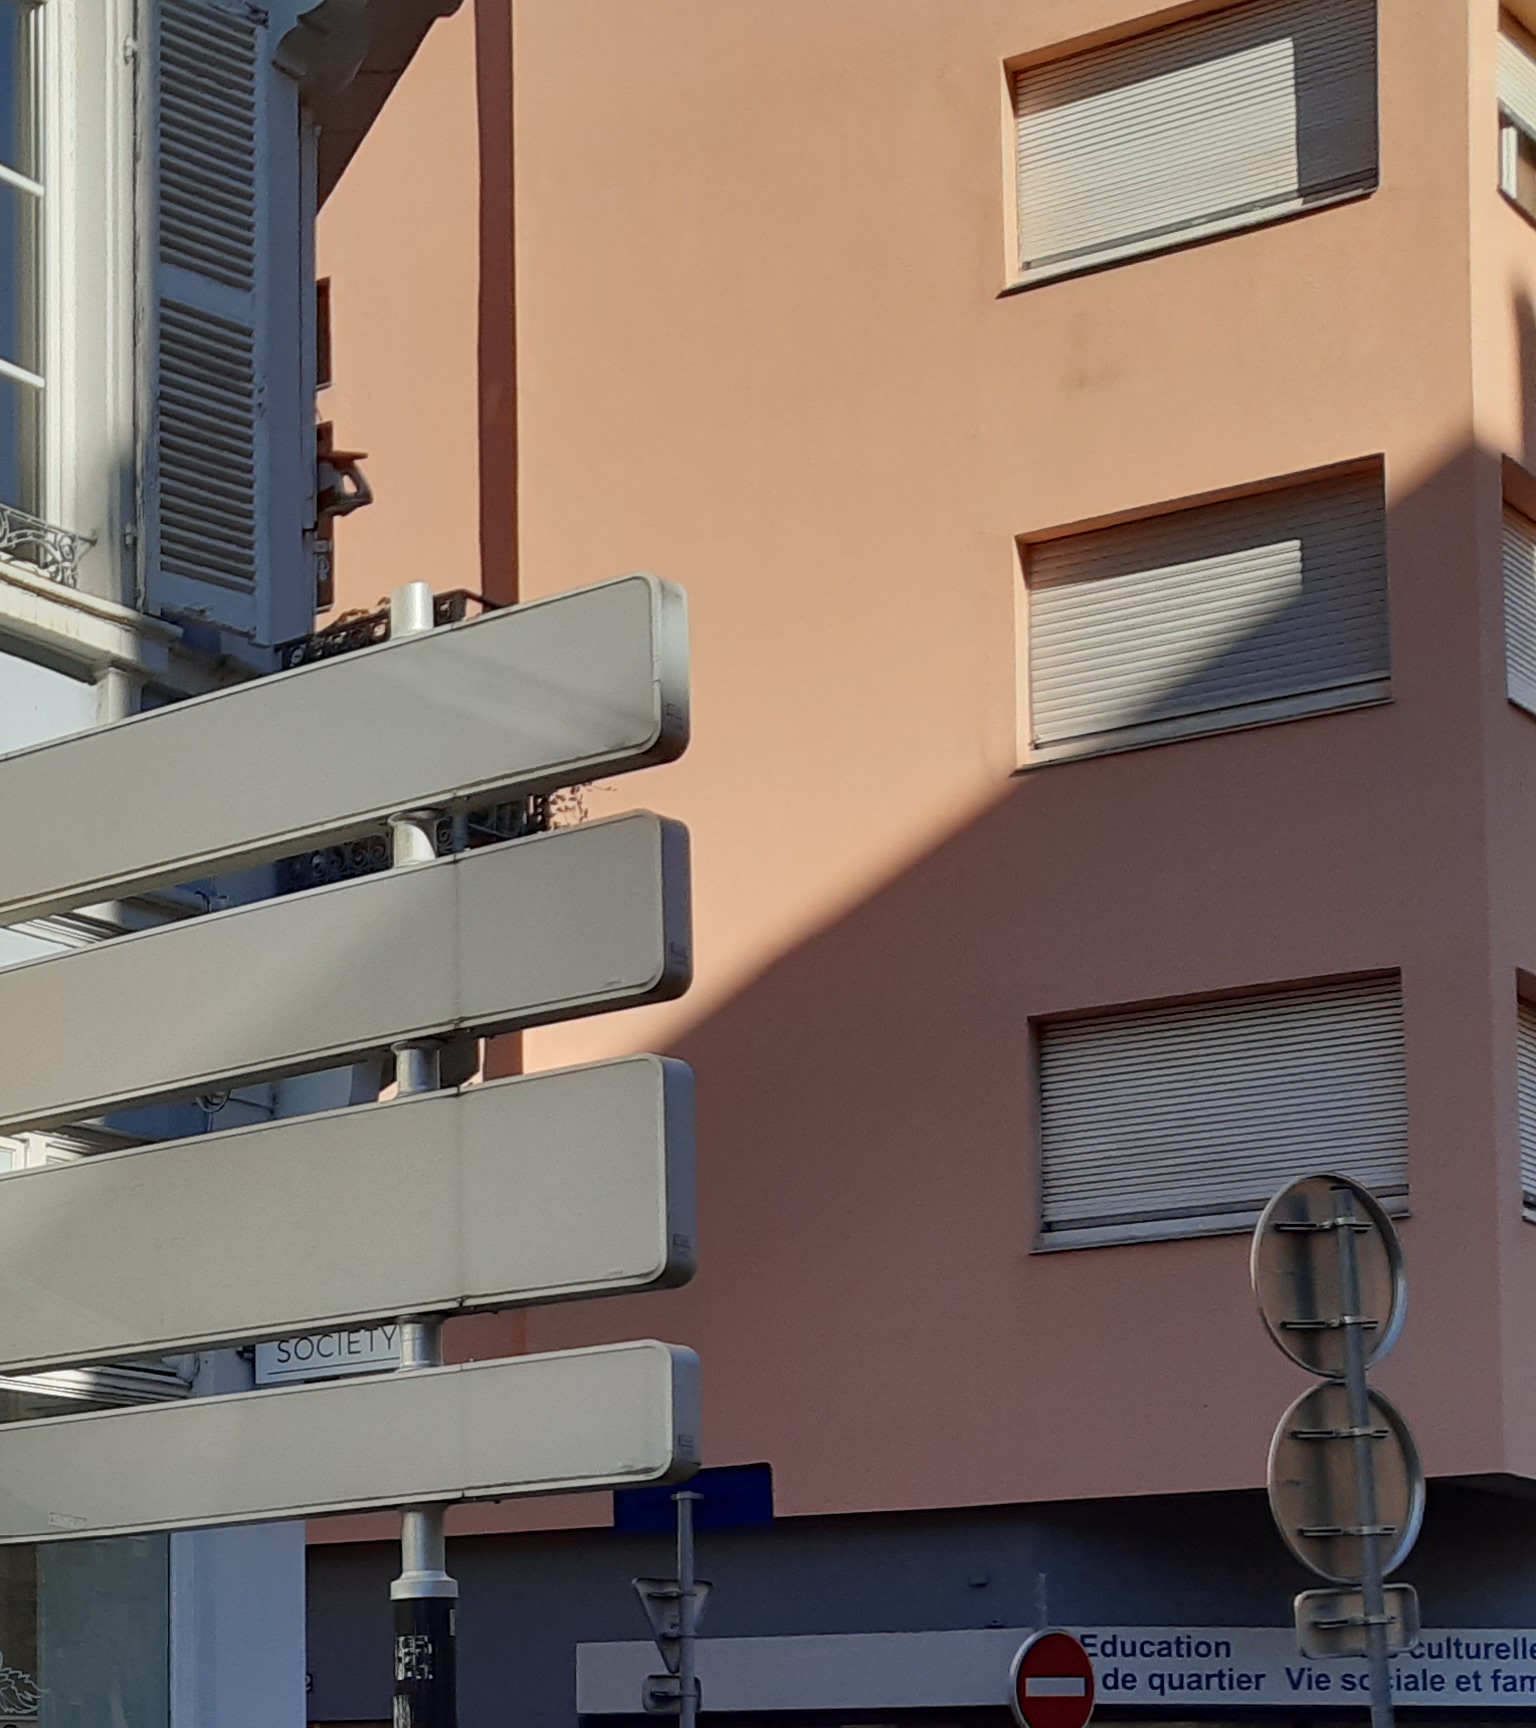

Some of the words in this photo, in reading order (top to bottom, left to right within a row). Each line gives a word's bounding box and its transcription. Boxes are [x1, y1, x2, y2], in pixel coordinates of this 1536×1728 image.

[276, 1323, 399, 1363] SOCIETY
[1079, 1634, 1231, 1658] Education
[1102, 1667, 1137, 1691] de
[1148, 1667, 1266, 1696] quartier
[1285, 1667, 1331, 1691] Vie
[1341, 1668, 1445, 1692] soiale
[1455, 1669, 1482, 1692] et
